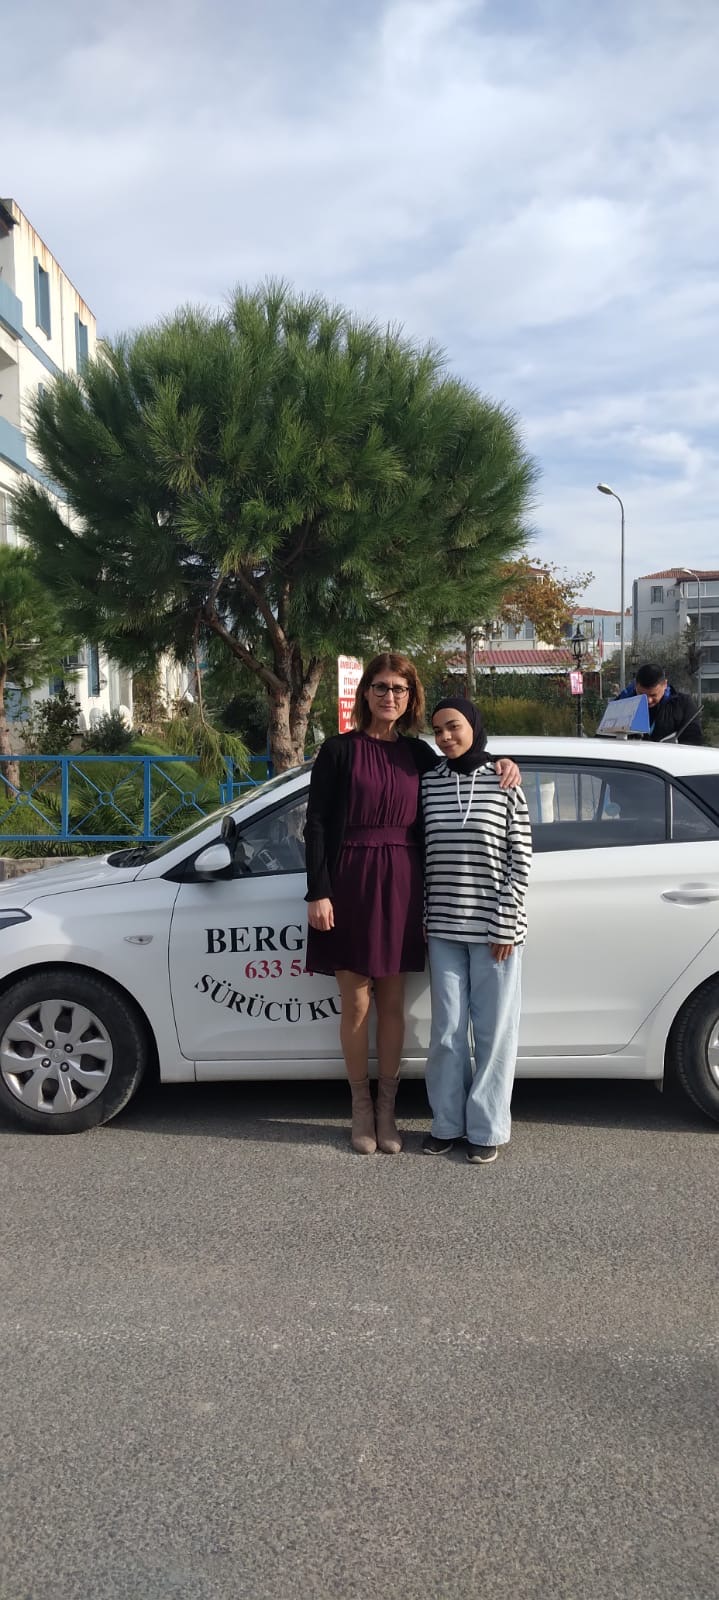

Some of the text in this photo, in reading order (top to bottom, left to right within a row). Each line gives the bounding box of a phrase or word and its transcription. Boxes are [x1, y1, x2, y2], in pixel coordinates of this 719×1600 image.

[204, 924, 305, 954] BERG
[244, 959, 283, 979] 633
[194, 974, 301, 1023] SÜRÜCÜ
